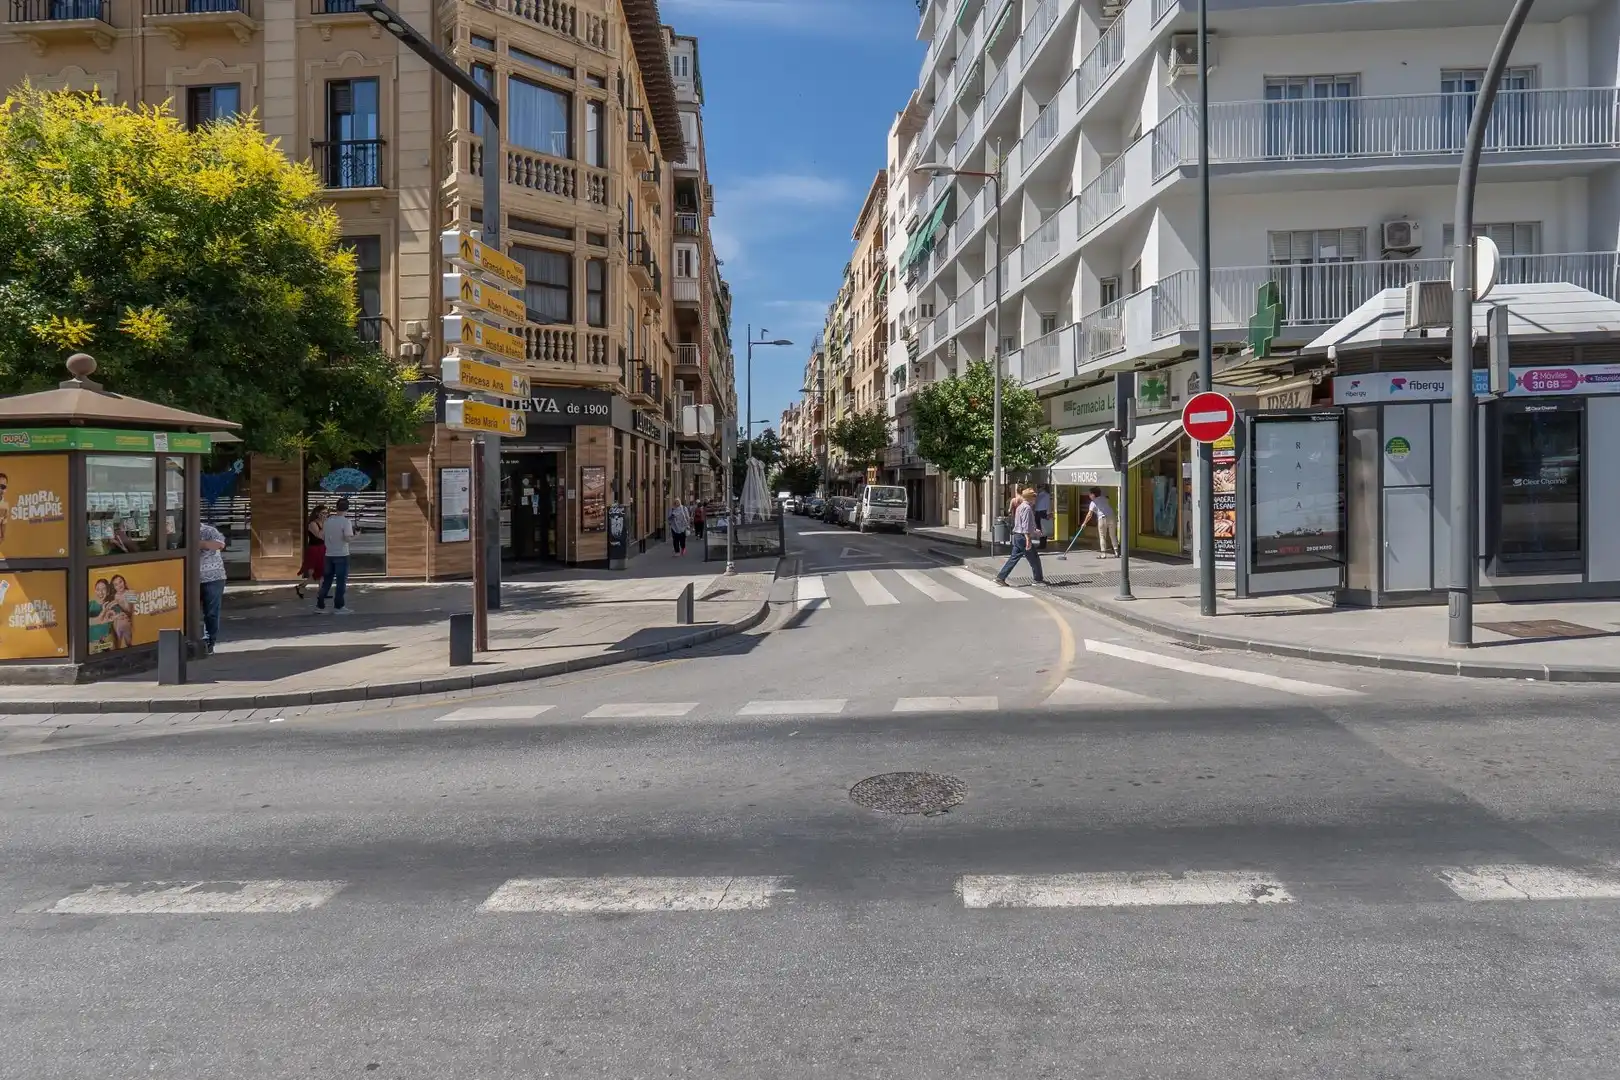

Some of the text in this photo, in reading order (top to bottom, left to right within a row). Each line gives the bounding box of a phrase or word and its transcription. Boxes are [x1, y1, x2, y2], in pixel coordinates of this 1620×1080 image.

[482, 258, 505, 277] Granada
[506, 269, 523, 285] Center
[486, 339, 504, 353] Hostal
[461, 371, 504, 391] Princesa Ana
[1532, 371, 1539, 379] 2
[1594, 374, 1620, 382] Televisió
[1409, 380, 1445, 392] fibergy
[1532, 381, 1545, 389] 30
[1546, 380, 1560, 389] GB
[1345, 390, 1367, 398] fibergy
[502, 398, 608, 415] UEVA de 1900
[1073, 397, 1105, 416] Farmacia
[464, 413, 481, 426] Elena
[1070, 471, 1097, 483] 13 HORAS
[17, 490, 55, 507] AHORA
[11, 501, 64, 521] SIEMPRE
[140, 586, 171, 603] AHORA
[14, 600, 50, 613] AHORA
[134, 595, 177, 615] SIEMPRE
[9, 609, 56, 628] SIEMPRE
